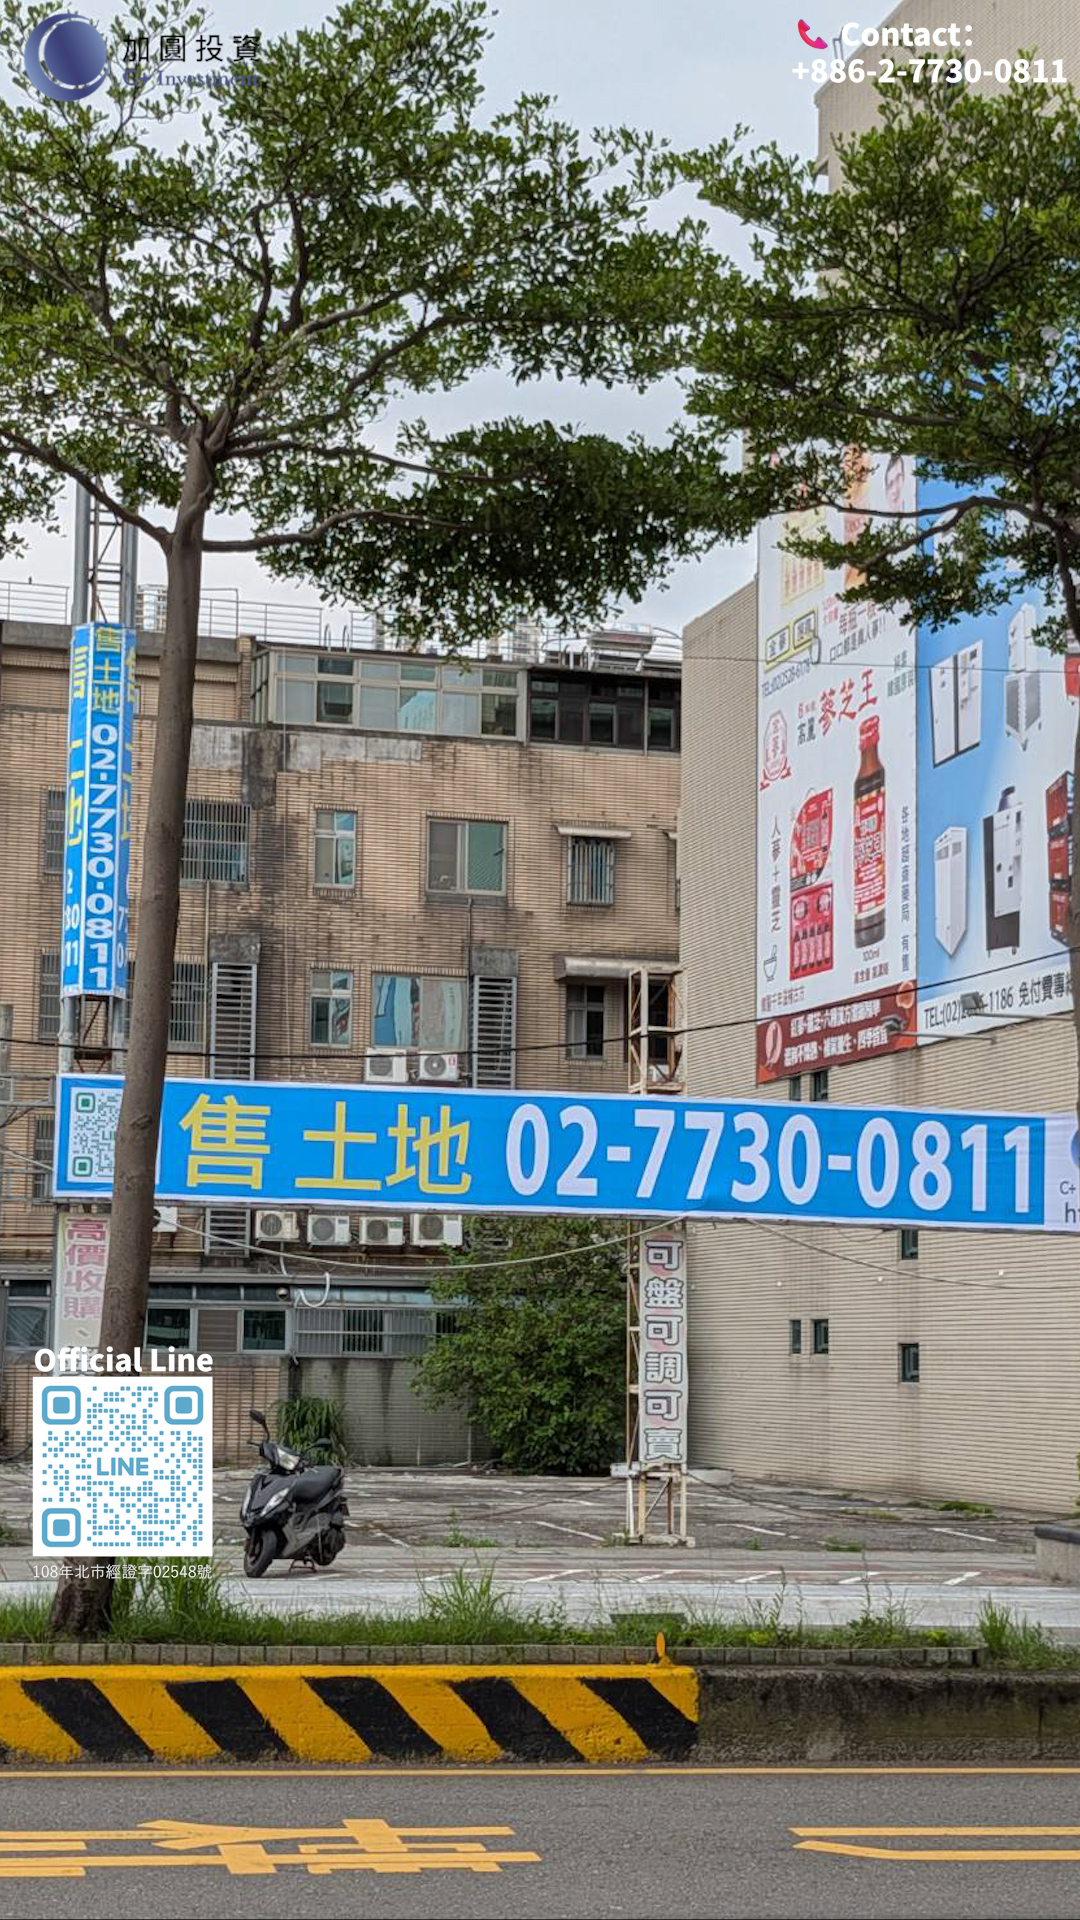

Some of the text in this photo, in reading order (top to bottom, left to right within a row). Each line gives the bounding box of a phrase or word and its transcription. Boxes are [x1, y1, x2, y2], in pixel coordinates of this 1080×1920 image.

[85, 626, 122, 988] 售土地 02-7730-0811
[179, 1094, 1030, 1214] 售土地 02-7730-0811
